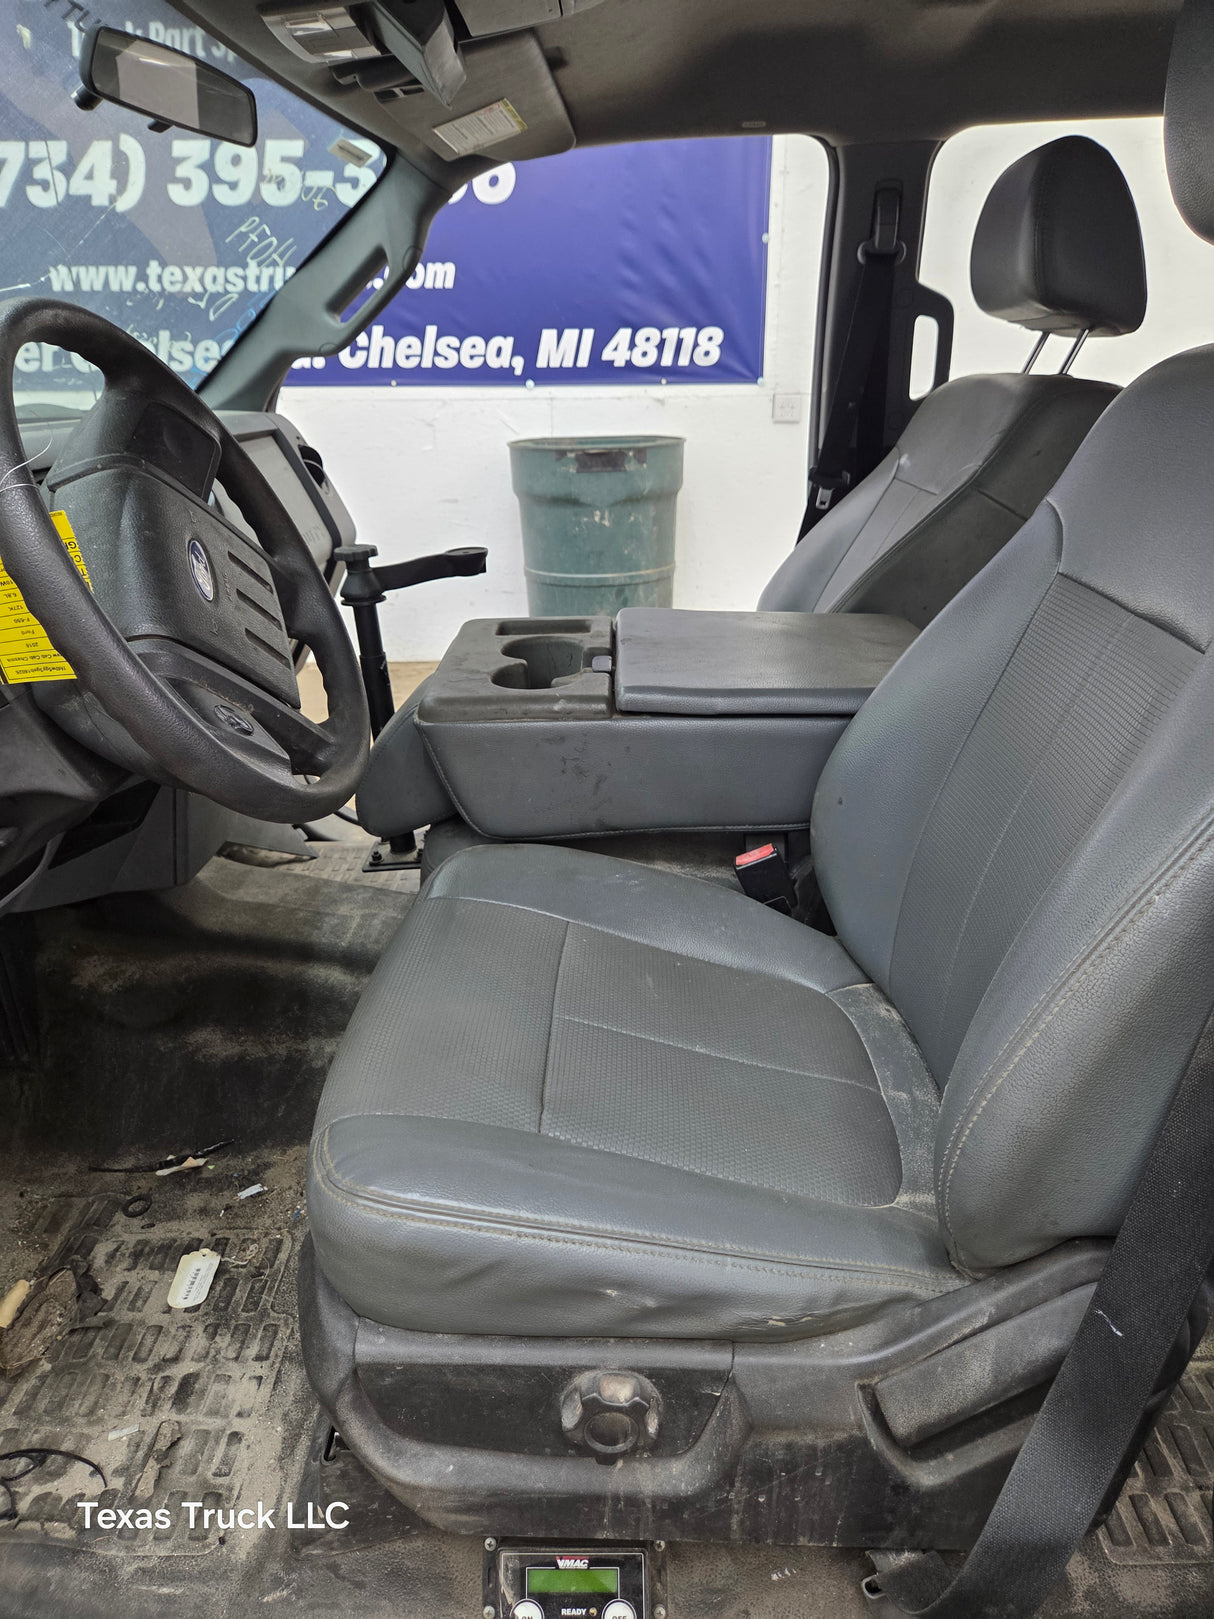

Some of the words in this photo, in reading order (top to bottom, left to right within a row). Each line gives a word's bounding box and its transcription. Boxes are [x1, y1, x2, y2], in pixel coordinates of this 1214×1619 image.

[338, 325, 525, 376] Chelsea,
[536, 328, 595, 368] MI
[601, 326, 725, 368] 48118
[556, 1556, 590, 1569] VMAC
[561, 1608, 587, 1616] READY
